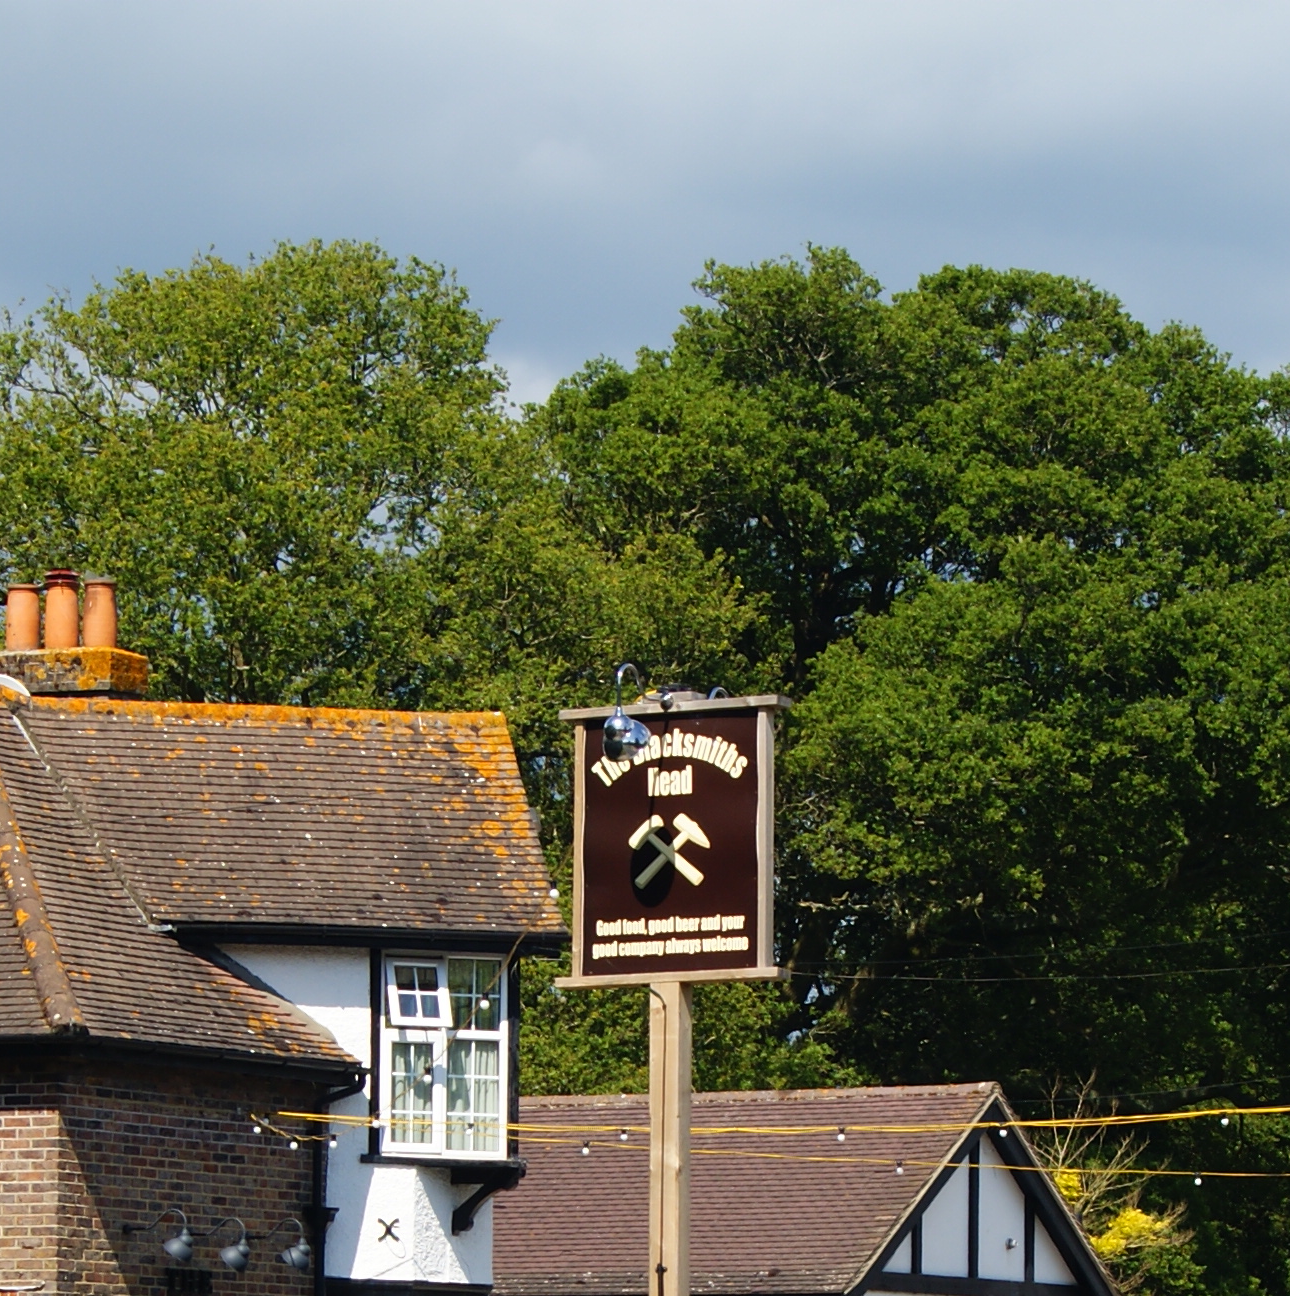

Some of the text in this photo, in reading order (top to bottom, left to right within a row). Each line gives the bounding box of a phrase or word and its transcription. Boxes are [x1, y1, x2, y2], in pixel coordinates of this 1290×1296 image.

[596, 919, 622, 937] Good
[648, 916, 674, 936] good
[675, 915, 700, 932] beer
[700, 913, 721, 931] and
[721, 915, 745, 932] your
[592, 935, 749, 960] good company always welcome
